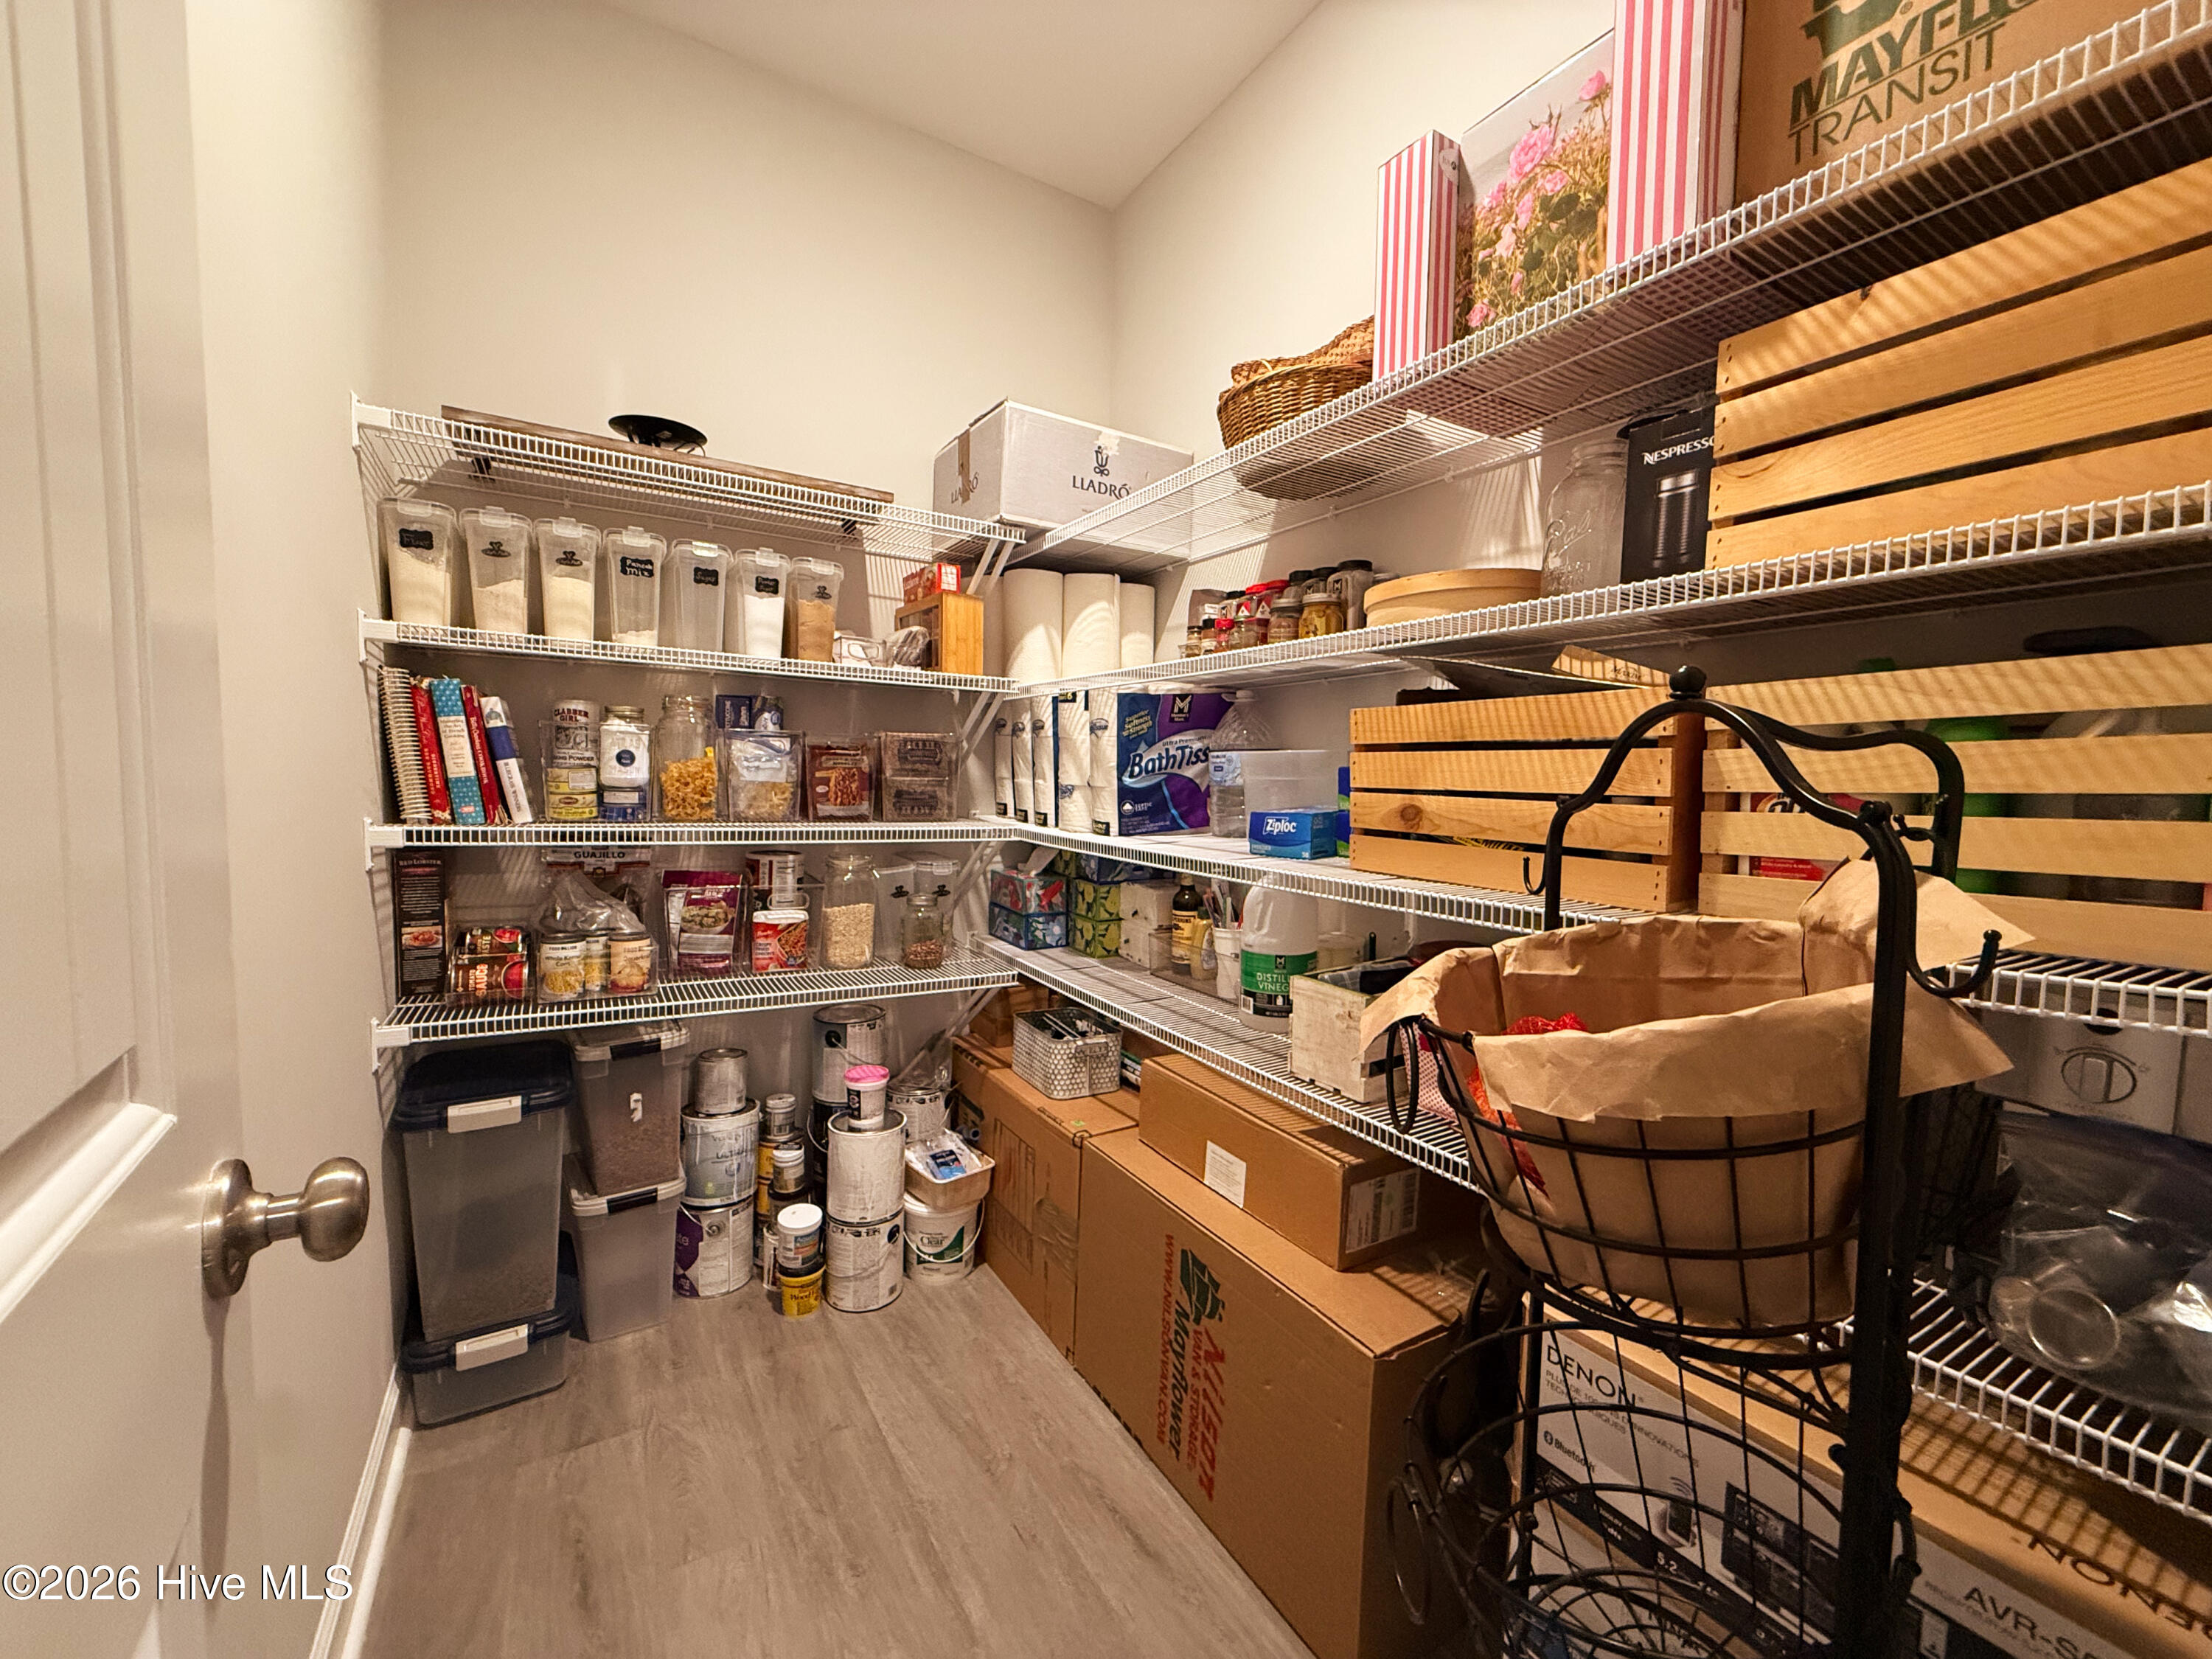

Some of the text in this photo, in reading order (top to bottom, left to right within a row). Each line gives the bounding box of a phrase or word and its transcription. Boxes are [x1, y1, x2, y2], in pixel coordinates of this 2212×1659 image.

[1790, 0, 2038, 132] MAYFL
[1789, 22, 2006, 165] TRANSIT
[1072, 475, 1130, 499] LLADRÓ
[554, 708, 588, 719] CLABBER
[1266, 818, 1297, 835] Ziploc
[574, 851, 626, 859] GUAJILLO
[481, 935, 491, 953] ASTE
[476, 964, 488, 997] SAUCE
[1256, 972, 1290, 983] DISTIL
[1258, 981, 1290, 992] VINEG
[920, 1236, 945, 1245] Clear
[1156, 1234, 1175, 1444] WWW.NILSONVAN.COM
[1192, 1329, 1203, 1366] VAN
[1169, 1300, 1190, 1461] Mayflower
[1547, 1345, 1637, 1408] DENON
[1187, 1383, 1200, 1470] STORAGE
[1198, 1326, 1225, 1502] Nilson
[1554, 1439, 1595, 1473] Bluetooh
[1964, 1587, 2096, 1659] AVR-S
